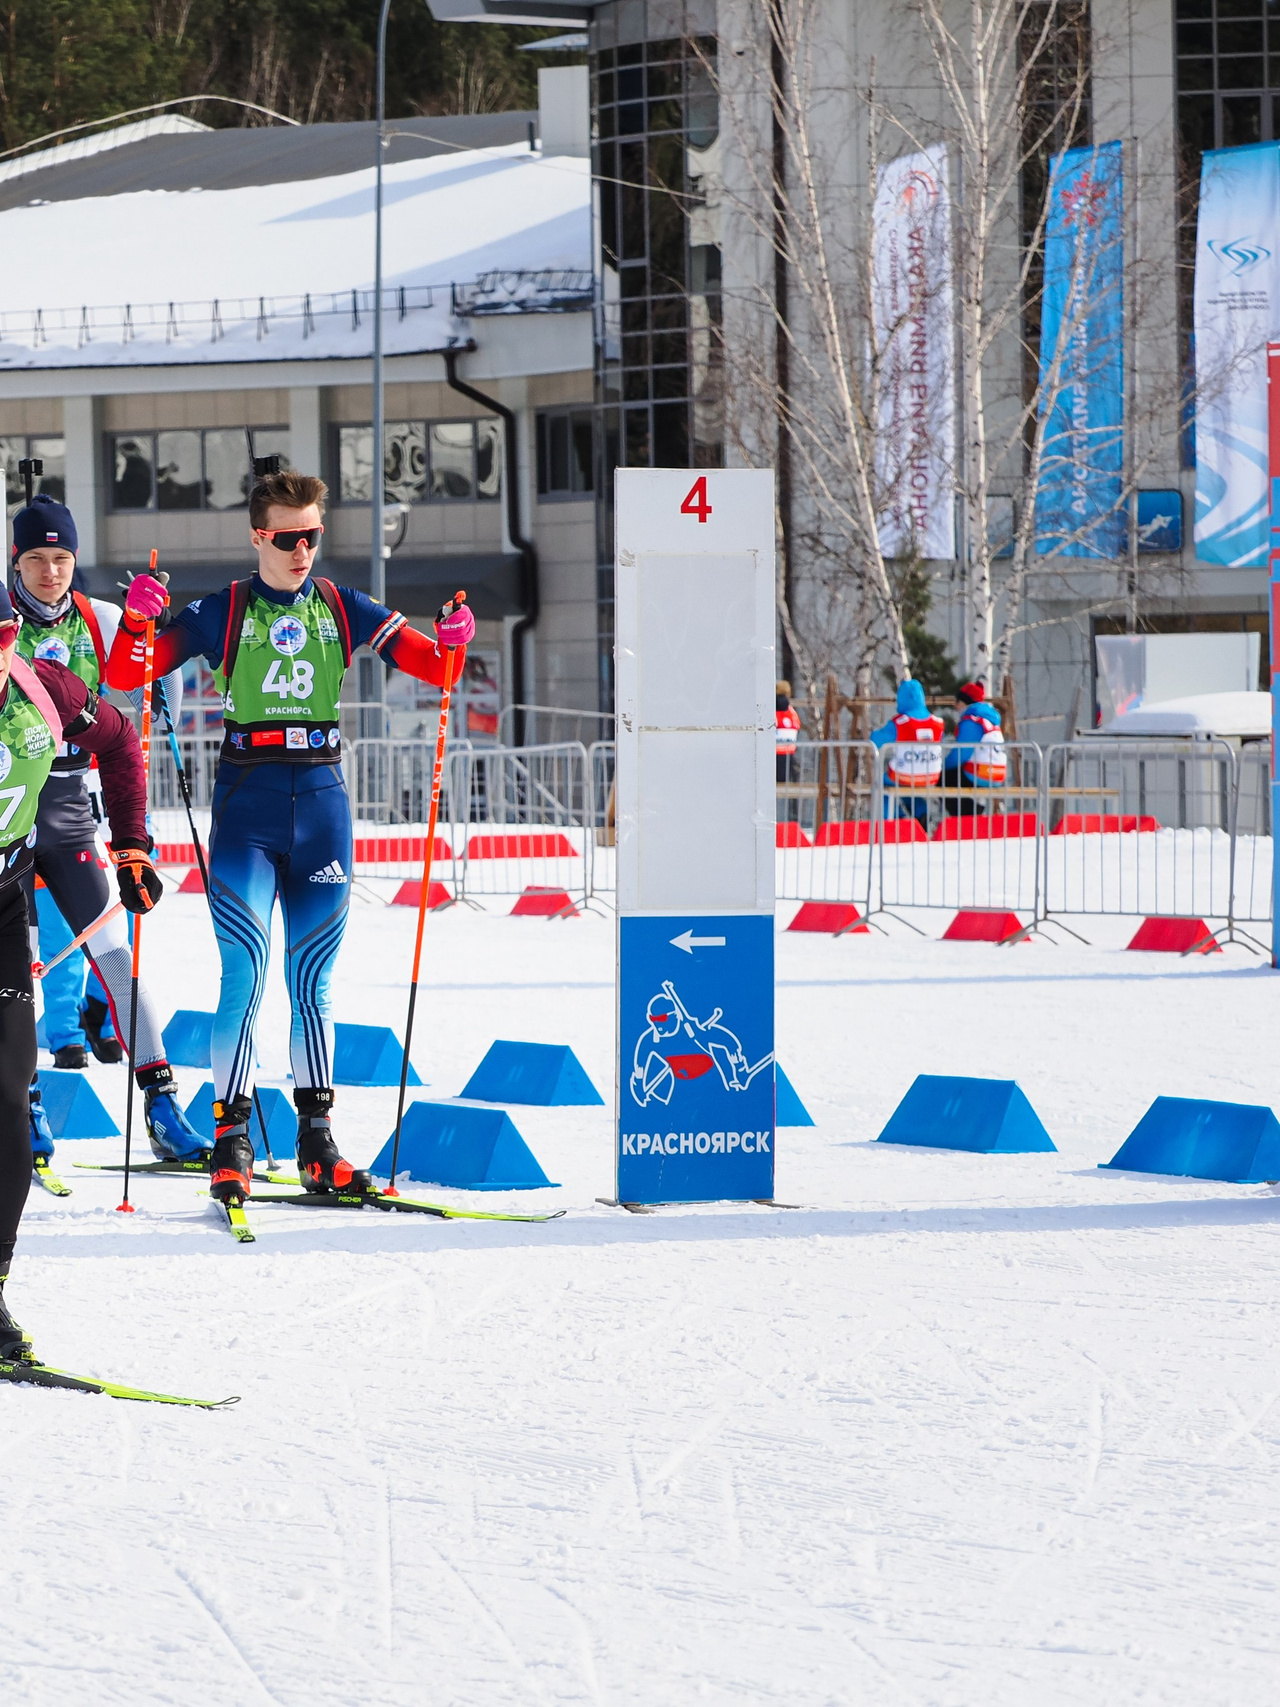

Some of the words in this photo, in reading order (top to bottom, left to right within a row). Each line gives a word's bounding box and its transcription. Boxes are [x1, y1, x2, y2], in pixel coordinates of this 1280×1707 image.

[681, 477, 712, 523] 4
[261, 659, 315, 699] 48
[309, 874, 348, 884] adidas
[315, 1092, 330, 1101] 198
[622, 1131, 770, 1155] КРАСНОЯРСК
